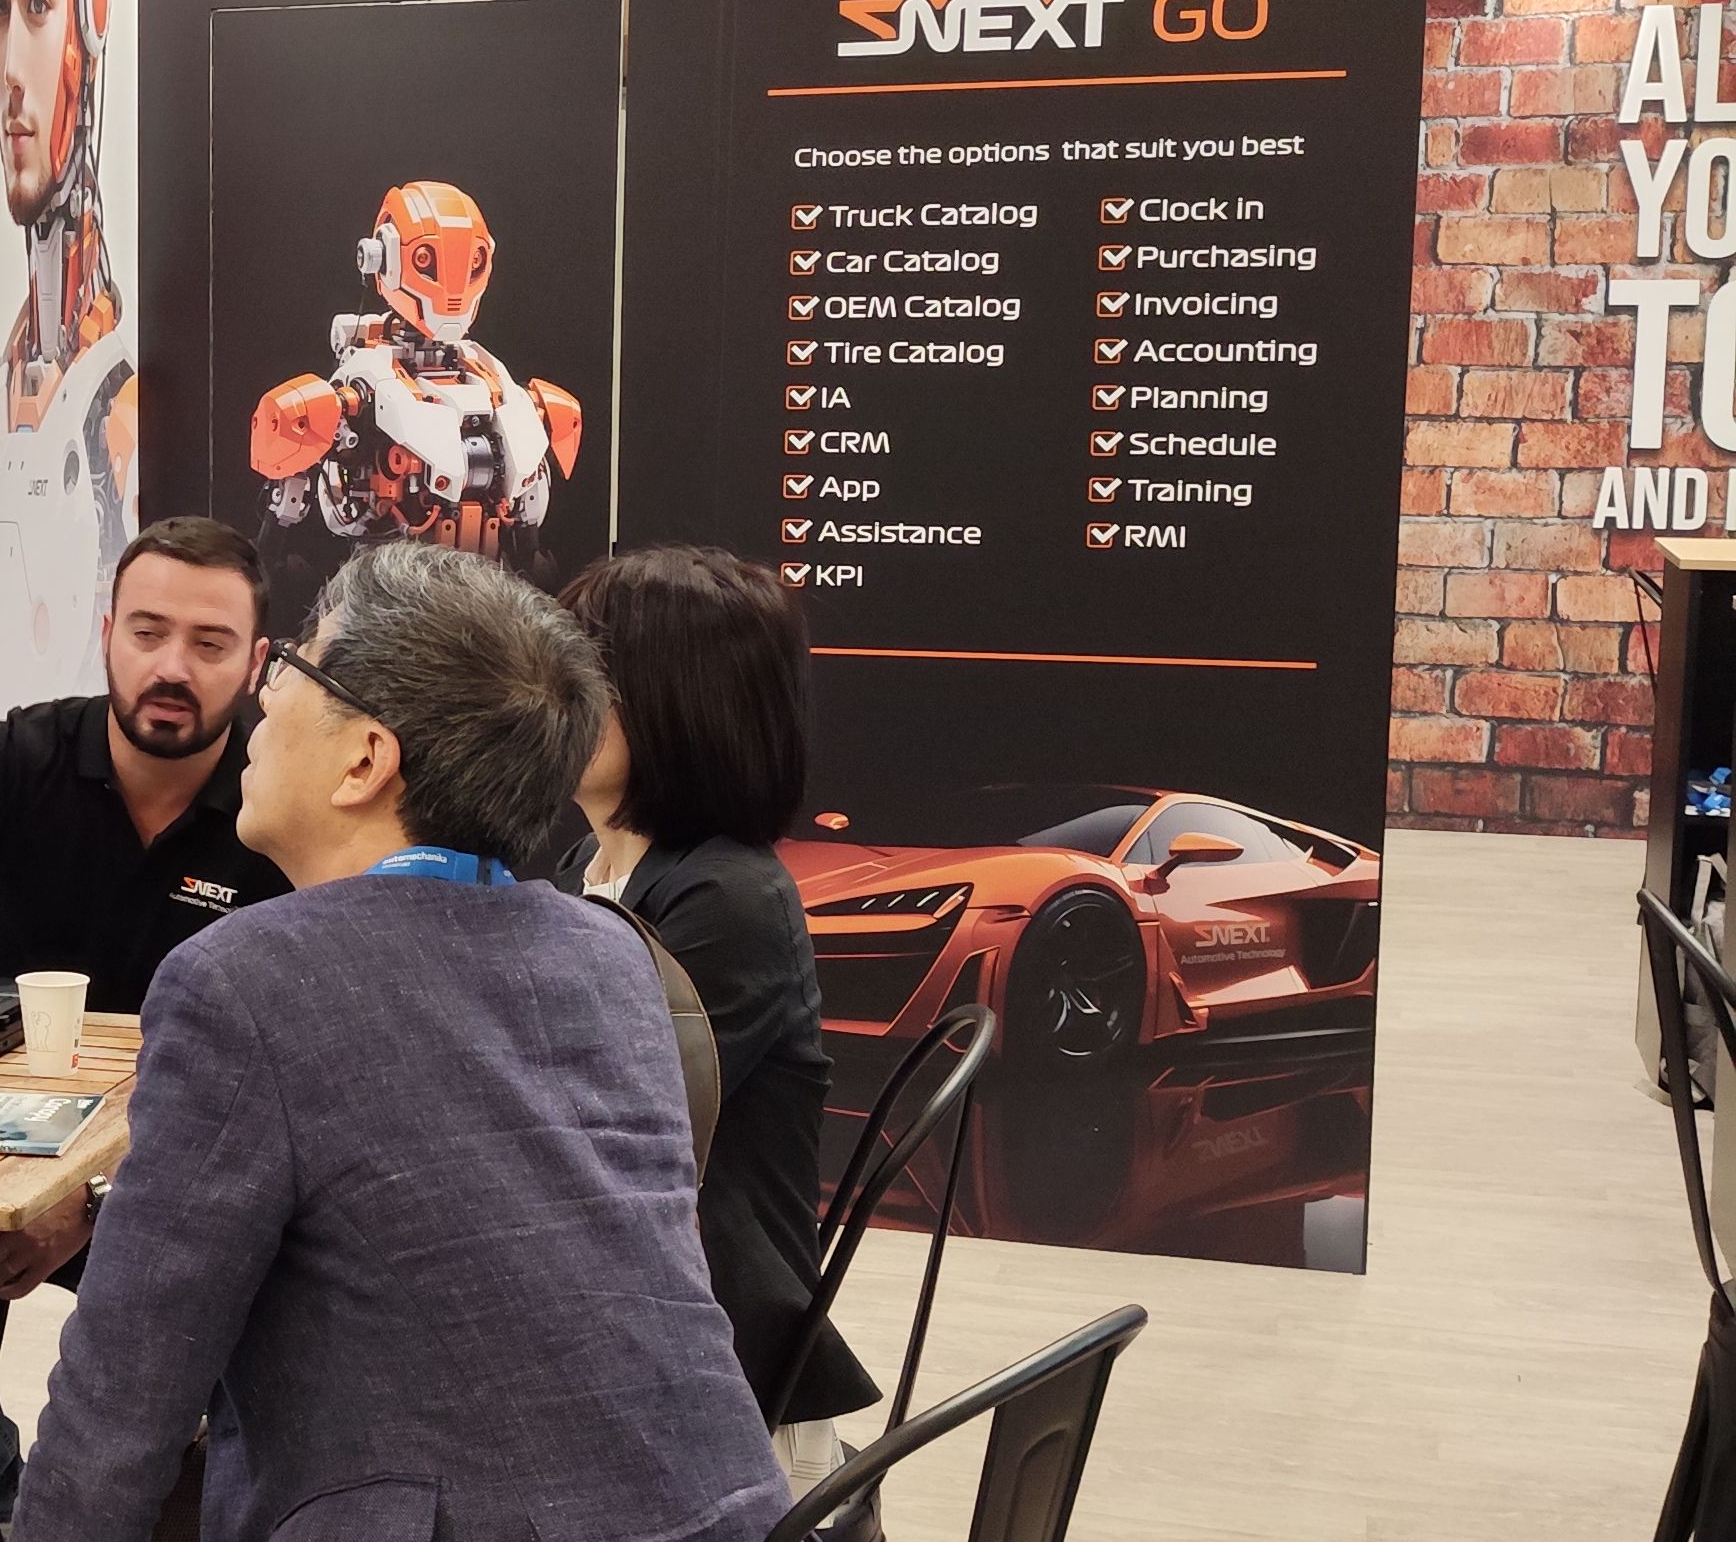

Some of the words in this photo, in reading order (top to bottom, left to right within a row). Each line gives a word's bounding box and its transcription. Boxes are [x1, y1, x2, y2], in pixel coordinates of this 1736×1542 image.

[794, 147, 893, 168] Choose
[897, 145, 942, 165] the
[948, 143, 1051, 167] options
[1061, 140, 1120, 160] that
[1124, 138, 1178, 159] suit
[1182, 138, 1235, 161] you
[1240, 135, 1306, 157] best
[828, 204, 914, 228] Truck
[920, 202, 1038, 229] Catalog
[1139, 197, 1229, 222] Clock
[1236, 197, 1265, 221] in
[825, 250, 878, 274] Car
[882, 249, 1000, 275] Catalog
[1136, 244, 1317, 272] Purchasing
[823, 295, 898, 319] OEM
[904, 295, 1022, 321] Catalog
[1134, 292, 1279, 319] Invoicing
[823, 340, 882, 365] Tire
[888, 340, 1006, 367] Catalog
[1132, 339, 1319, 367] Accounting
[820, 386, 852, 409] IA
[1129, 386, 1269, 414] Planning
[819, 431, 891, 454] CRM
[1128, 432, 1278, 457] Schedule
[818, 475, 881, 502] App
[1126, 478, 1254, 507] Training
[1592, 466, 1710, 531] AND
[816, 520, 983, 545] Assistance
[1123, 524, 1187, 549] RMI
[814, 564, 864, 588] KPI
[1180, 952, 1235, 965] Automotive
